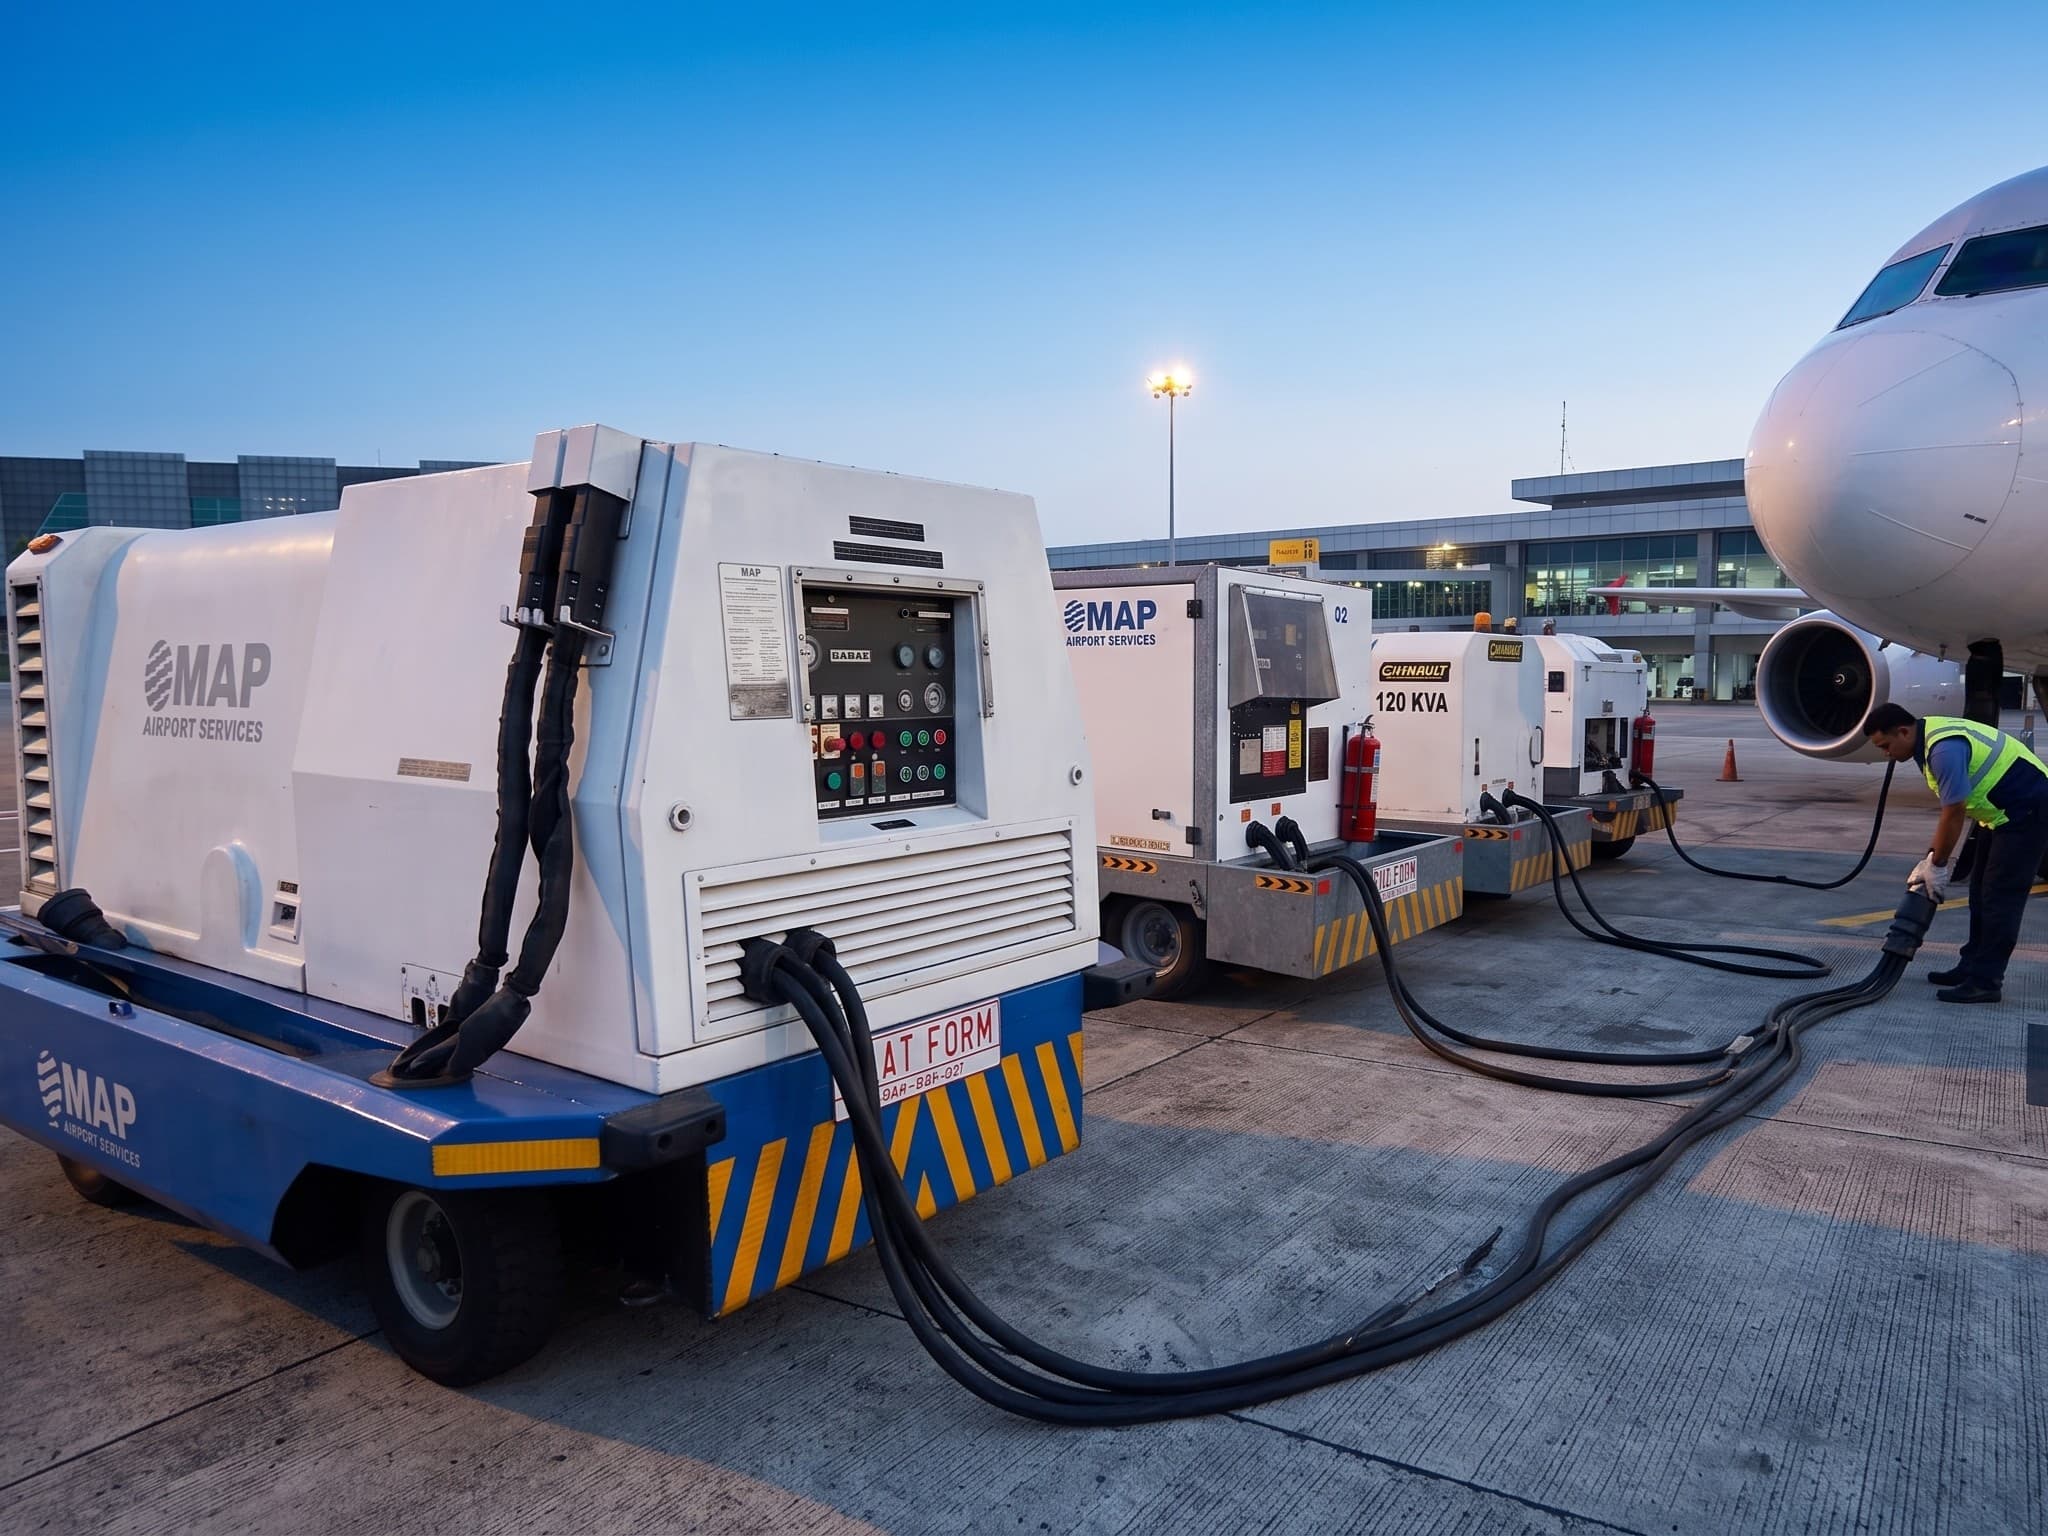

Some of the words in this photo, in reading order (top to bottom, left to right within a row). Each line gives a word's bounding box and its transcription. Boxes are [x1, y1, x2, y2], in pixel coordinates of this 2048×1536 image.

[741, 567, 761, 577] MAP
[1087, 600, 1157, 630] MAP
[1335, 606, 1348, 623] 02
[1066, 636, 1106, 646] AIRPORT
[1108, 634, 1156, 646] SERVICES
[173, 643, 271, 708] MAP
[1376, 691, 1406, 712] 120
[1412, 692, 1448, 712] KVA
[143, 716, 197, 738] AIRPORT
[199, 718, 263, 743] SERVICES
[882, 1034, 913, 1079] AT
[928, 1008, 992, 1064] FORM
[62, 1061, 136, 1140] MAP
[100, 1138, 140, 1168] SERVICES
